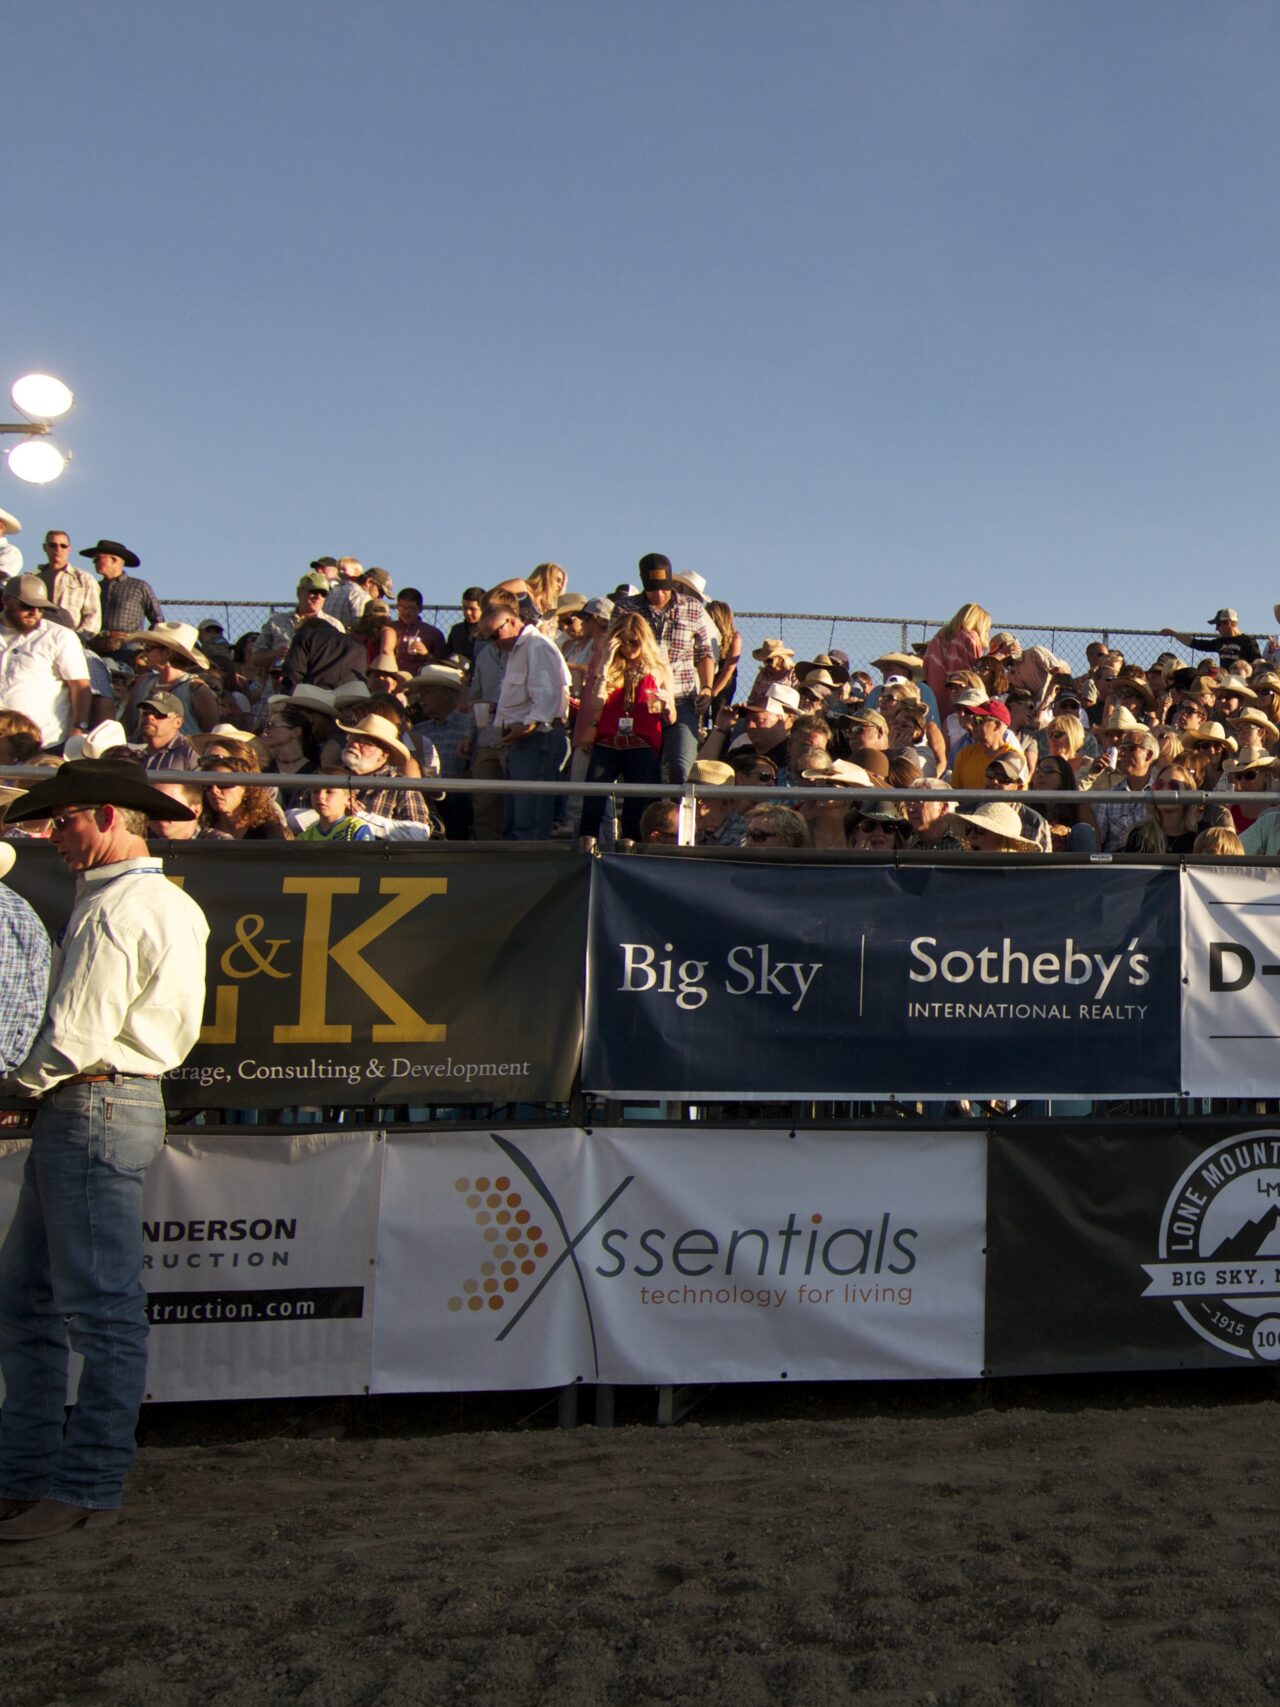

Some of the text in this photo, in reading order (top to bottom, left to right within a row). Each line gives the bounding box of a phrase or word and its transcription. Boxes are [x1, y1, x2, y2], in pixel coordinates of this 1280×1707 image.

[617, 942, 823, 1011] Big Sky
[909, 936, 1150, 999] Sotheby's
[908, 1003, 1149, 1020] INTERNATIONAL REALTY
[238, 1058, 362, 1085] Consulting
[366, 1058, 385, 1078] &
[391, 1057, 531, 1083] Development
[1171, 1187, 1208, 1250] LONE
[1172, 1271, 1206, 1286] BIG
[1216, 1269, 1265, 1285] SKY,
[640, 1284, 913, 1308] technology for living
[1211, 1311, 1245, 1337] 1915
